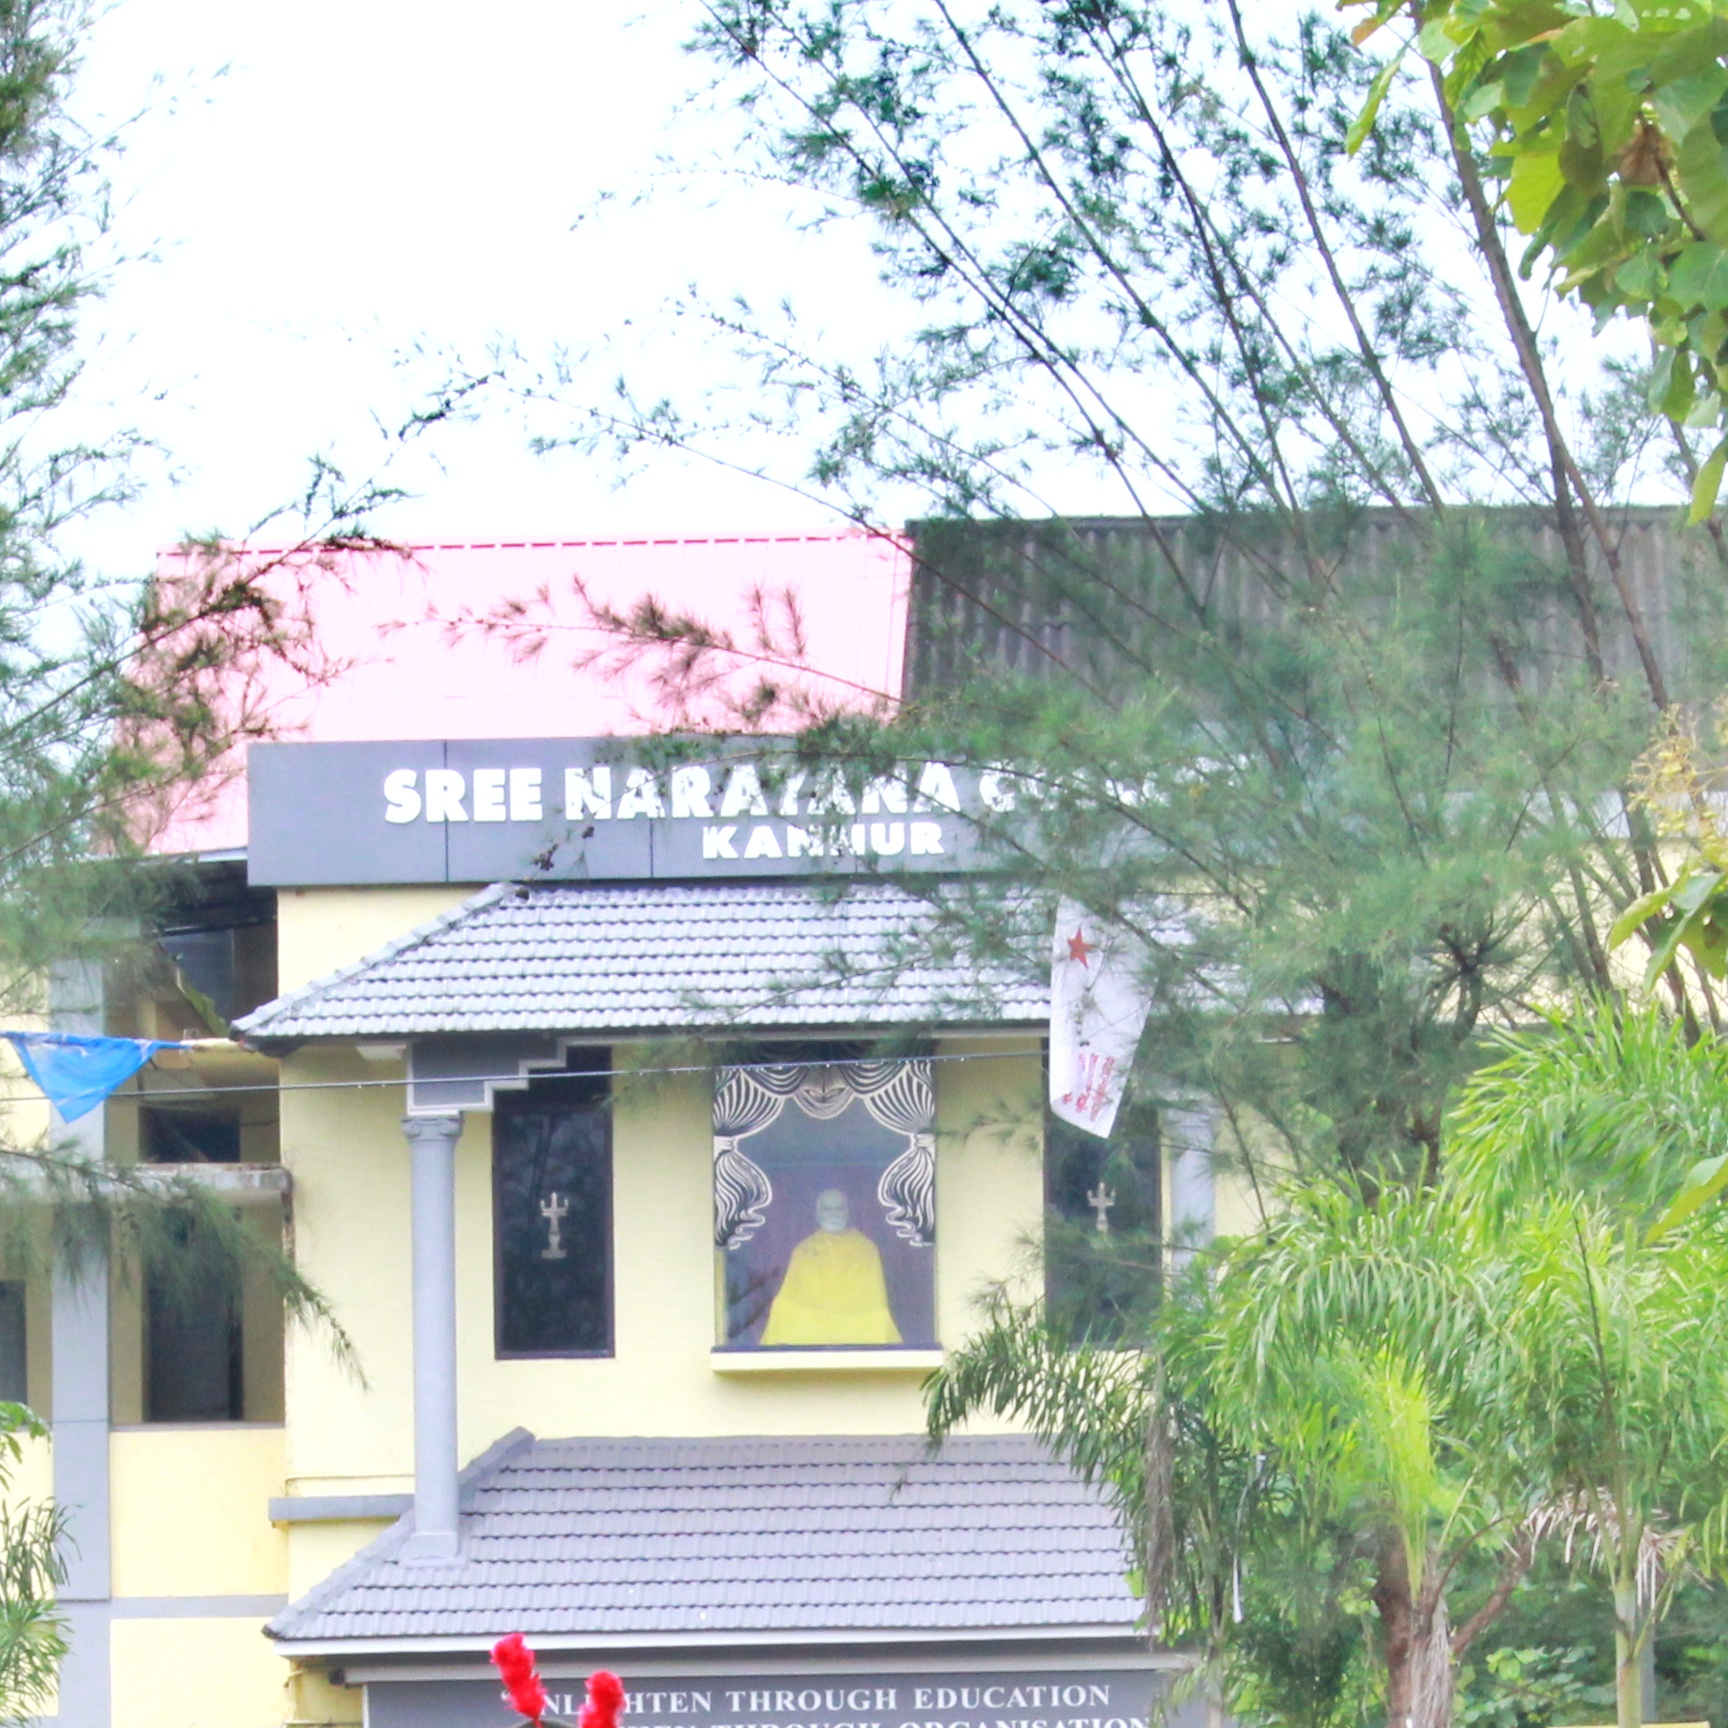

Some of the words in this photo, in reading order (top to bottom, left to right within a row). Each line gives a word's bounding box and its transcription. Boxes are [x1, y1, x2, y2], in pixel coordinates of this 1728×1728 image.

[384, 766, 543, 823] SREE
[726, 1688, 897, 1715] THROUGH
[914, 1684, 1111, 1711] EDUCATION
